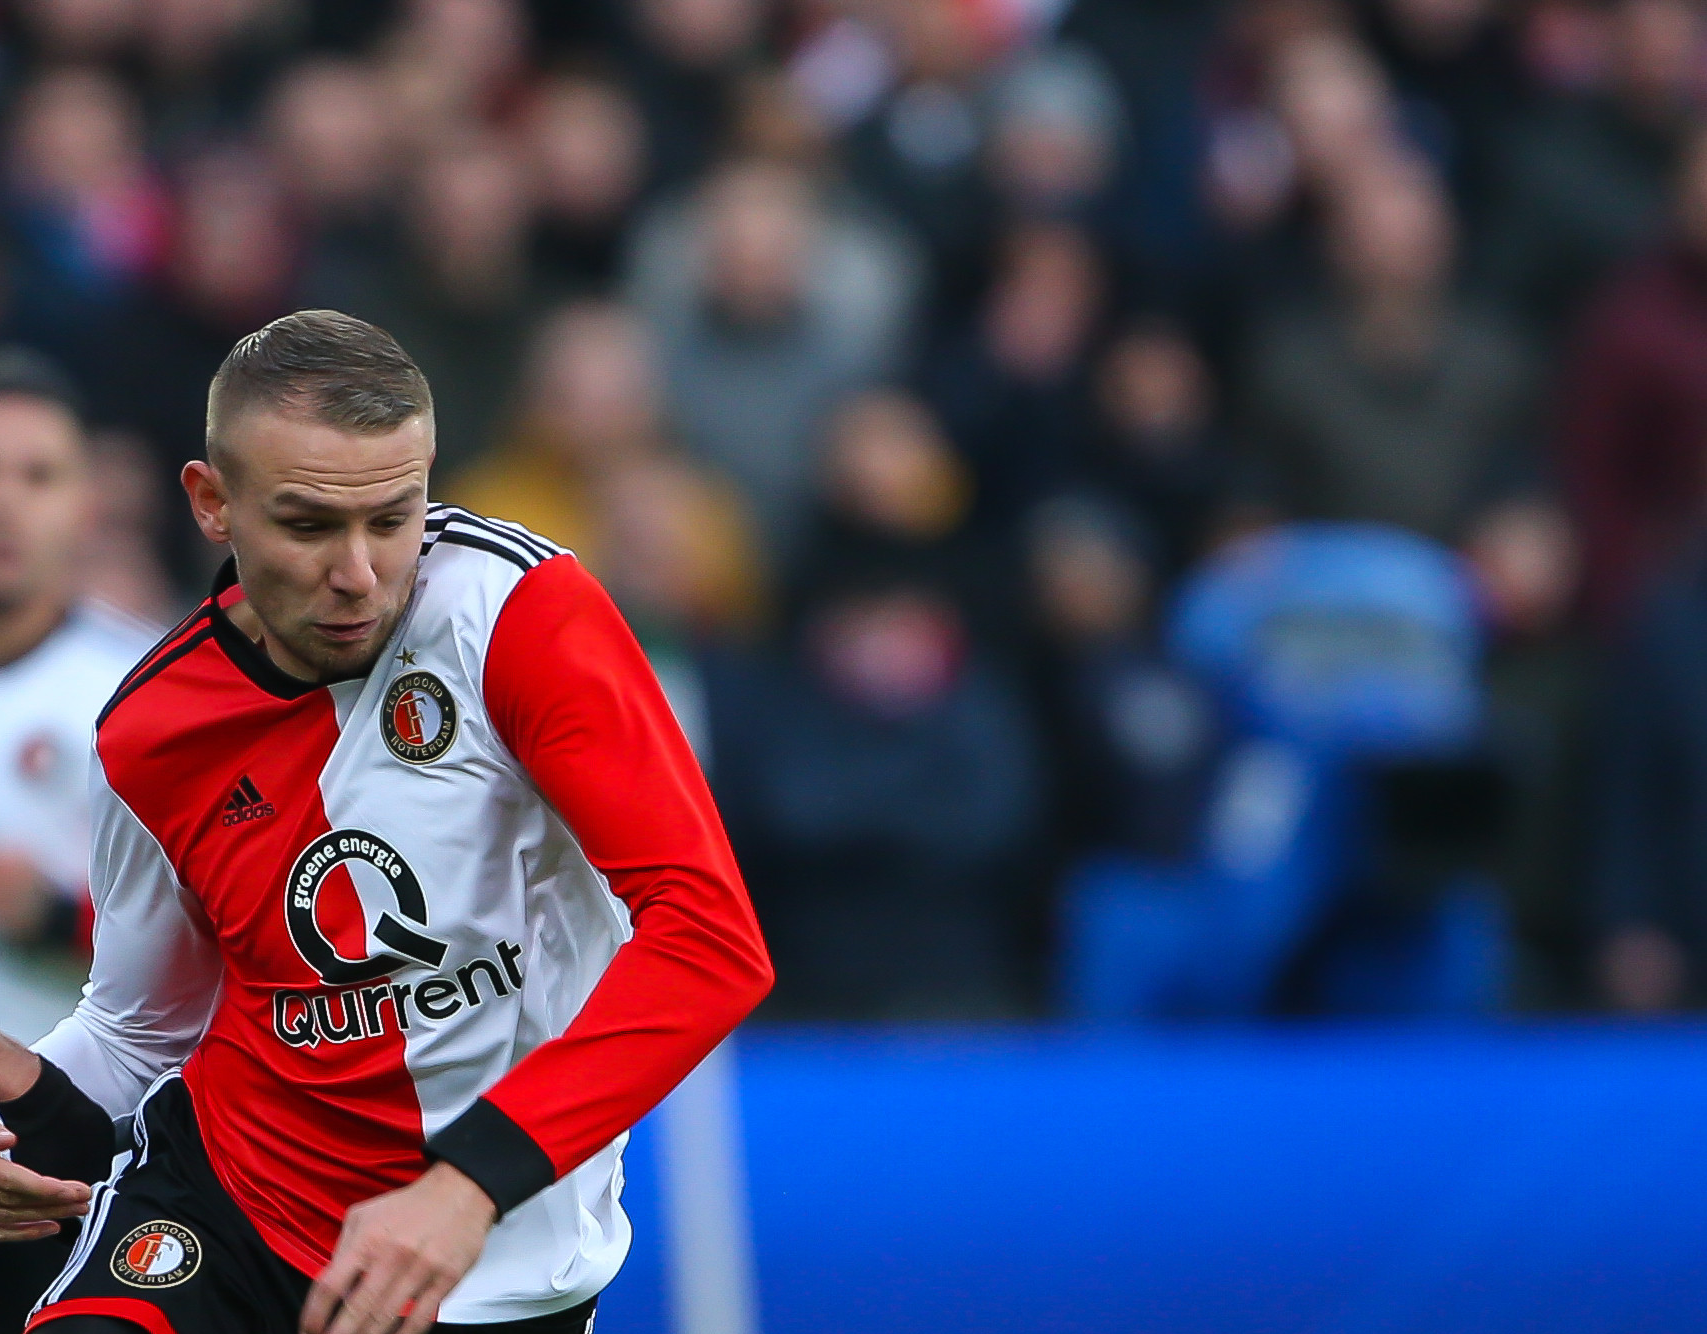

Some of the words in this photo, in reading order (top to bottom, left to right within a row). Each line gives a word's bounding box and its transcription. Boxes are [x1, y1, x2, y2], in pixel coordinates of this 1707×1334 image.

[222, 802, 276, 827] adidas
[293, 844, 337, 910] groene
[339, 837, 402, 879] energie
[272, 939, 524, 1049] Qurrent
